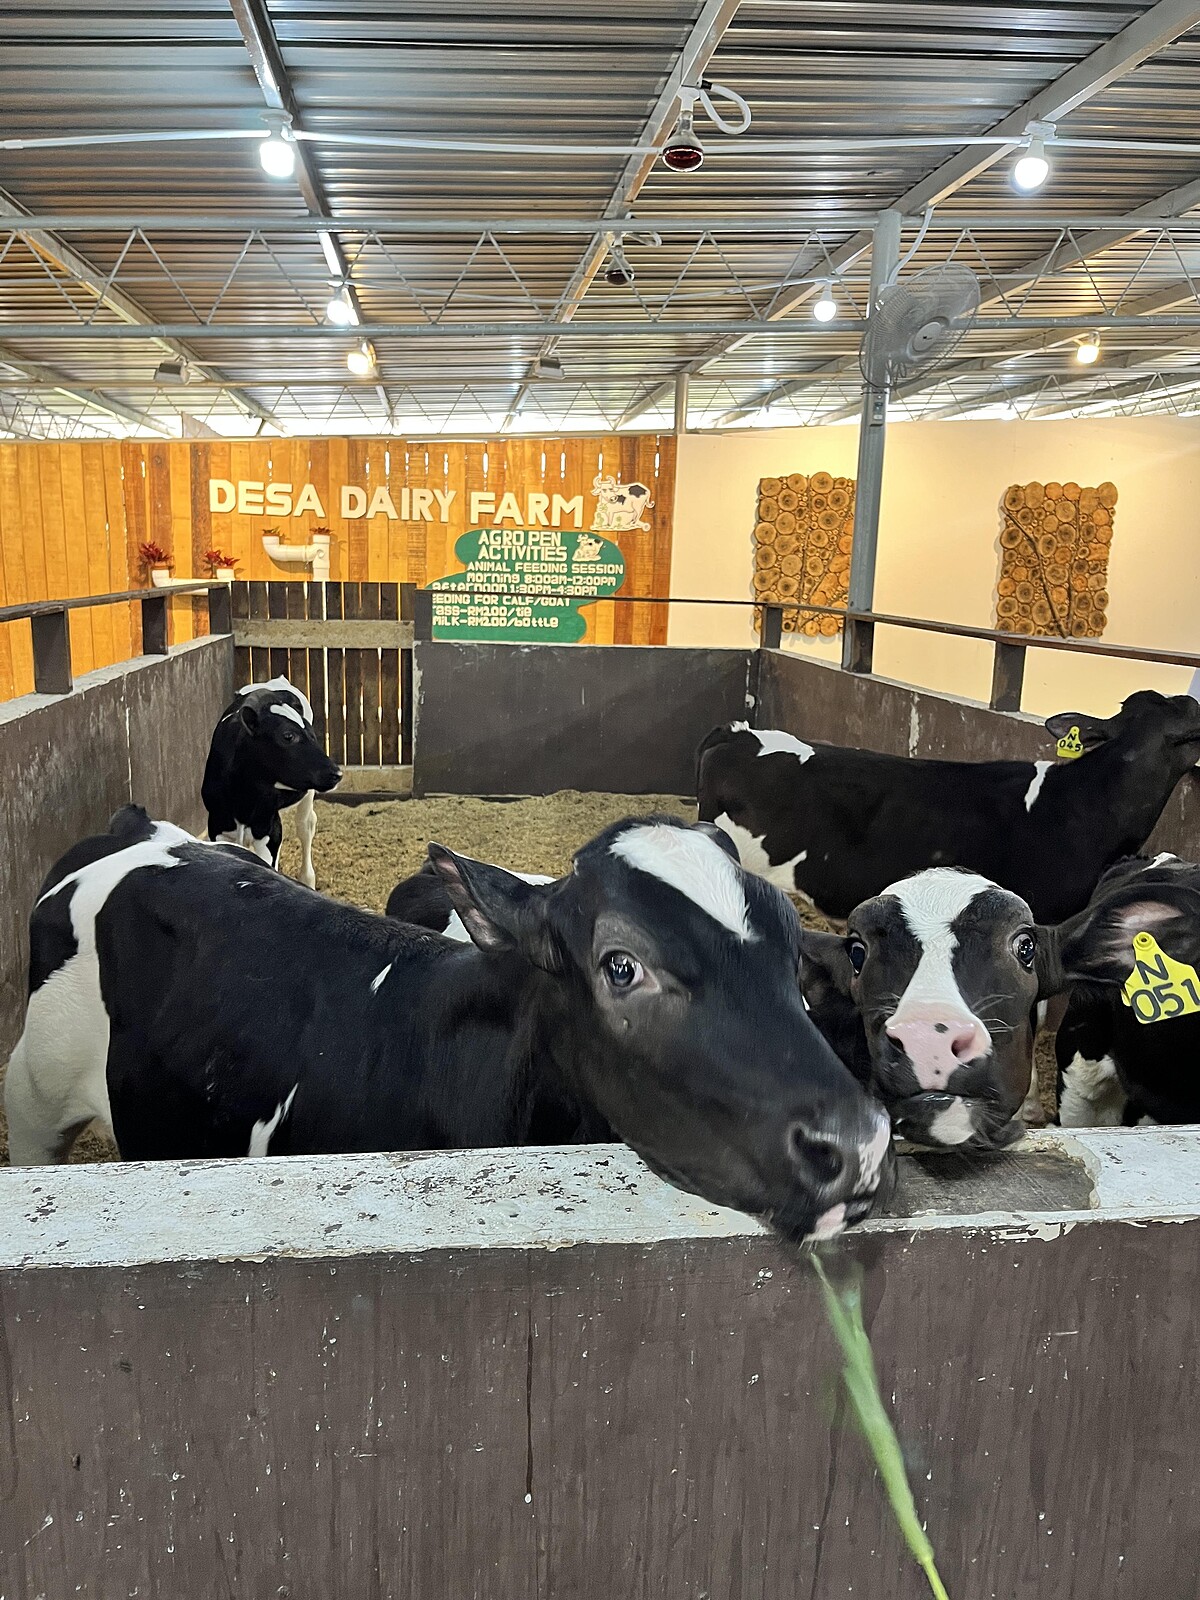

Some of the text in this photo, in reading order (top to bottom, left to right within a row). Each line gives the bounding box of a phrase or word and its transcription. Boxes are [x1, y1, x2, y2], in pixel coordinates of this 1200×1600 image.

[209, 479, 584, 528] DESA DAIRY FARM
[478, 530, 561, 547] AGRO PEN
[478, 545, 567, 562] ACTIVITIES
[467, 562, 624, 575] ANIMAL FEEDING SESSION
[474, 594, 499, 605] FOR
[502, 595, 570, 606] CALF/GOAT
[1059, 739, 1083, 752] 045
[1067, 733, 1077, 741] N
[1135, 953, 1169, 985] N
[1130, 978, 1200, 1022] 051
